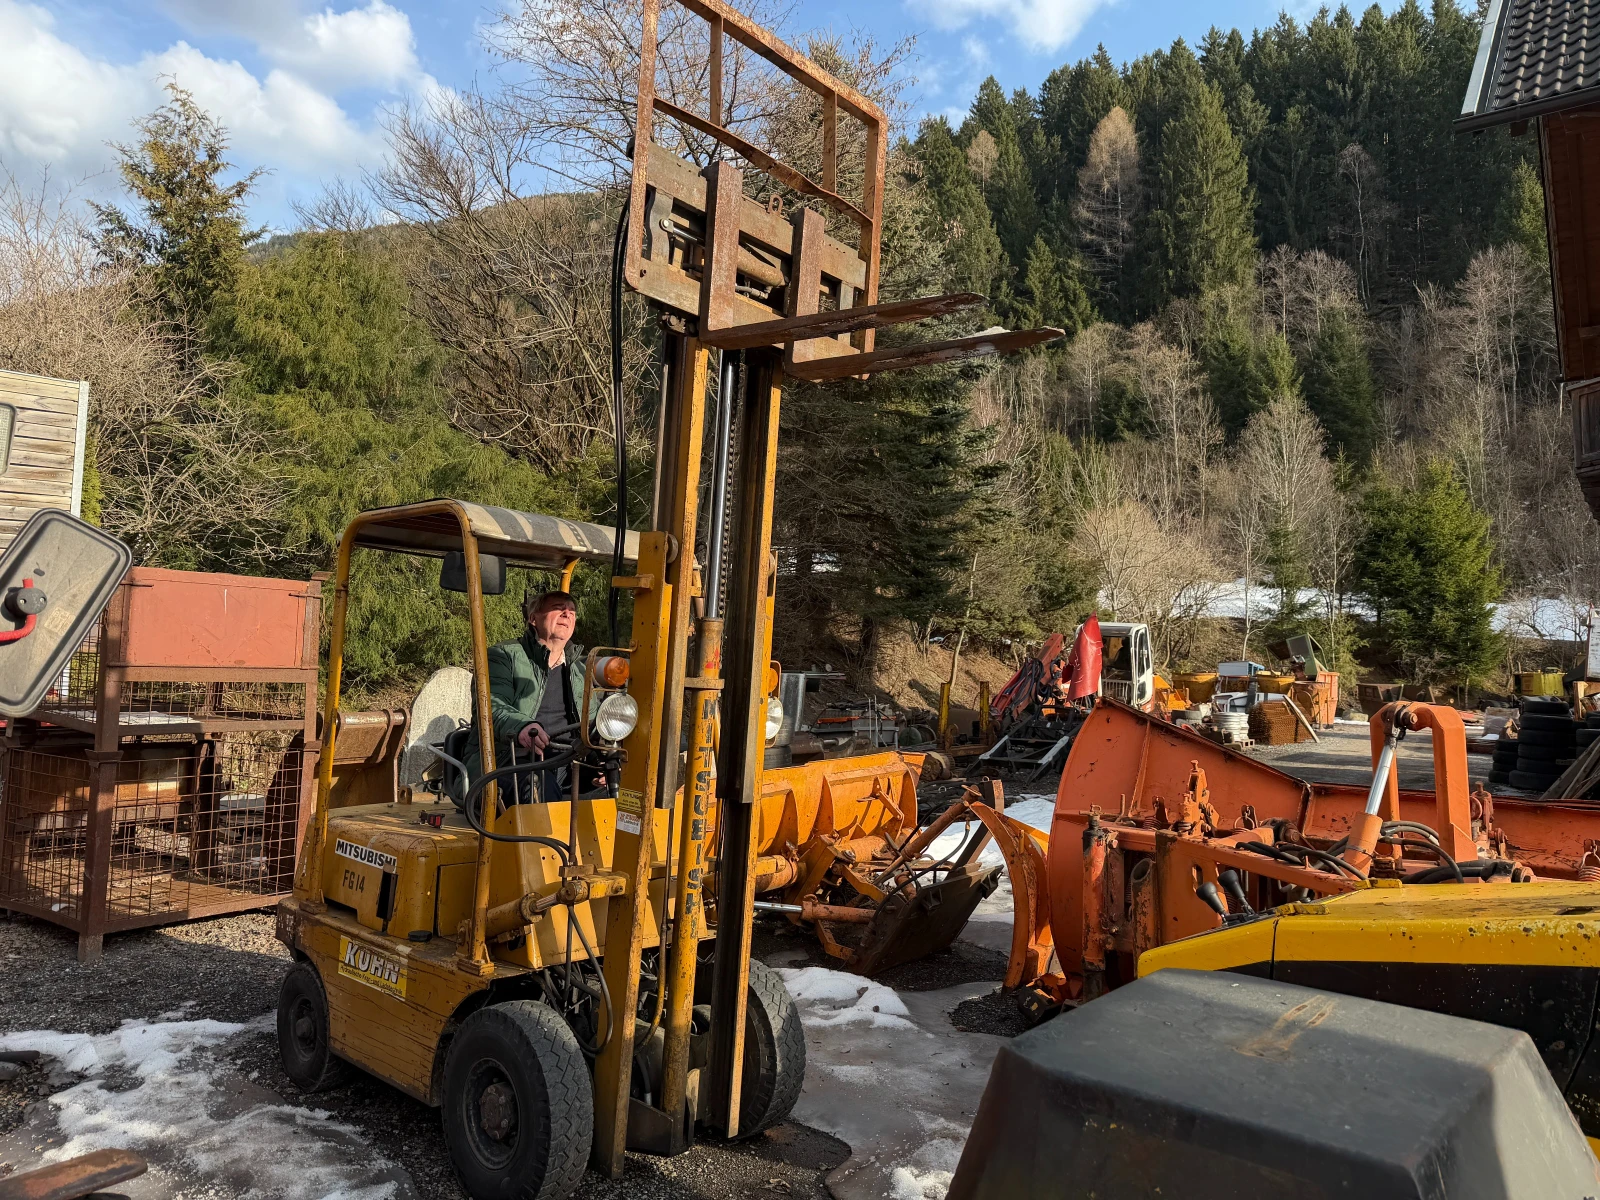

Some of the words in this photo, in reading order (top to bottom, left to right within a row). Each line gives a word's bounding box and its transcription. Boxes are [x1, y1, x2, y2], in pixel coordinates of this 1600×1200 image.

[336, 840, 396, 867] MITSUBISHI
[342, 869, 365, 893] FG14
[344, 942, 400, 984] KUHN
